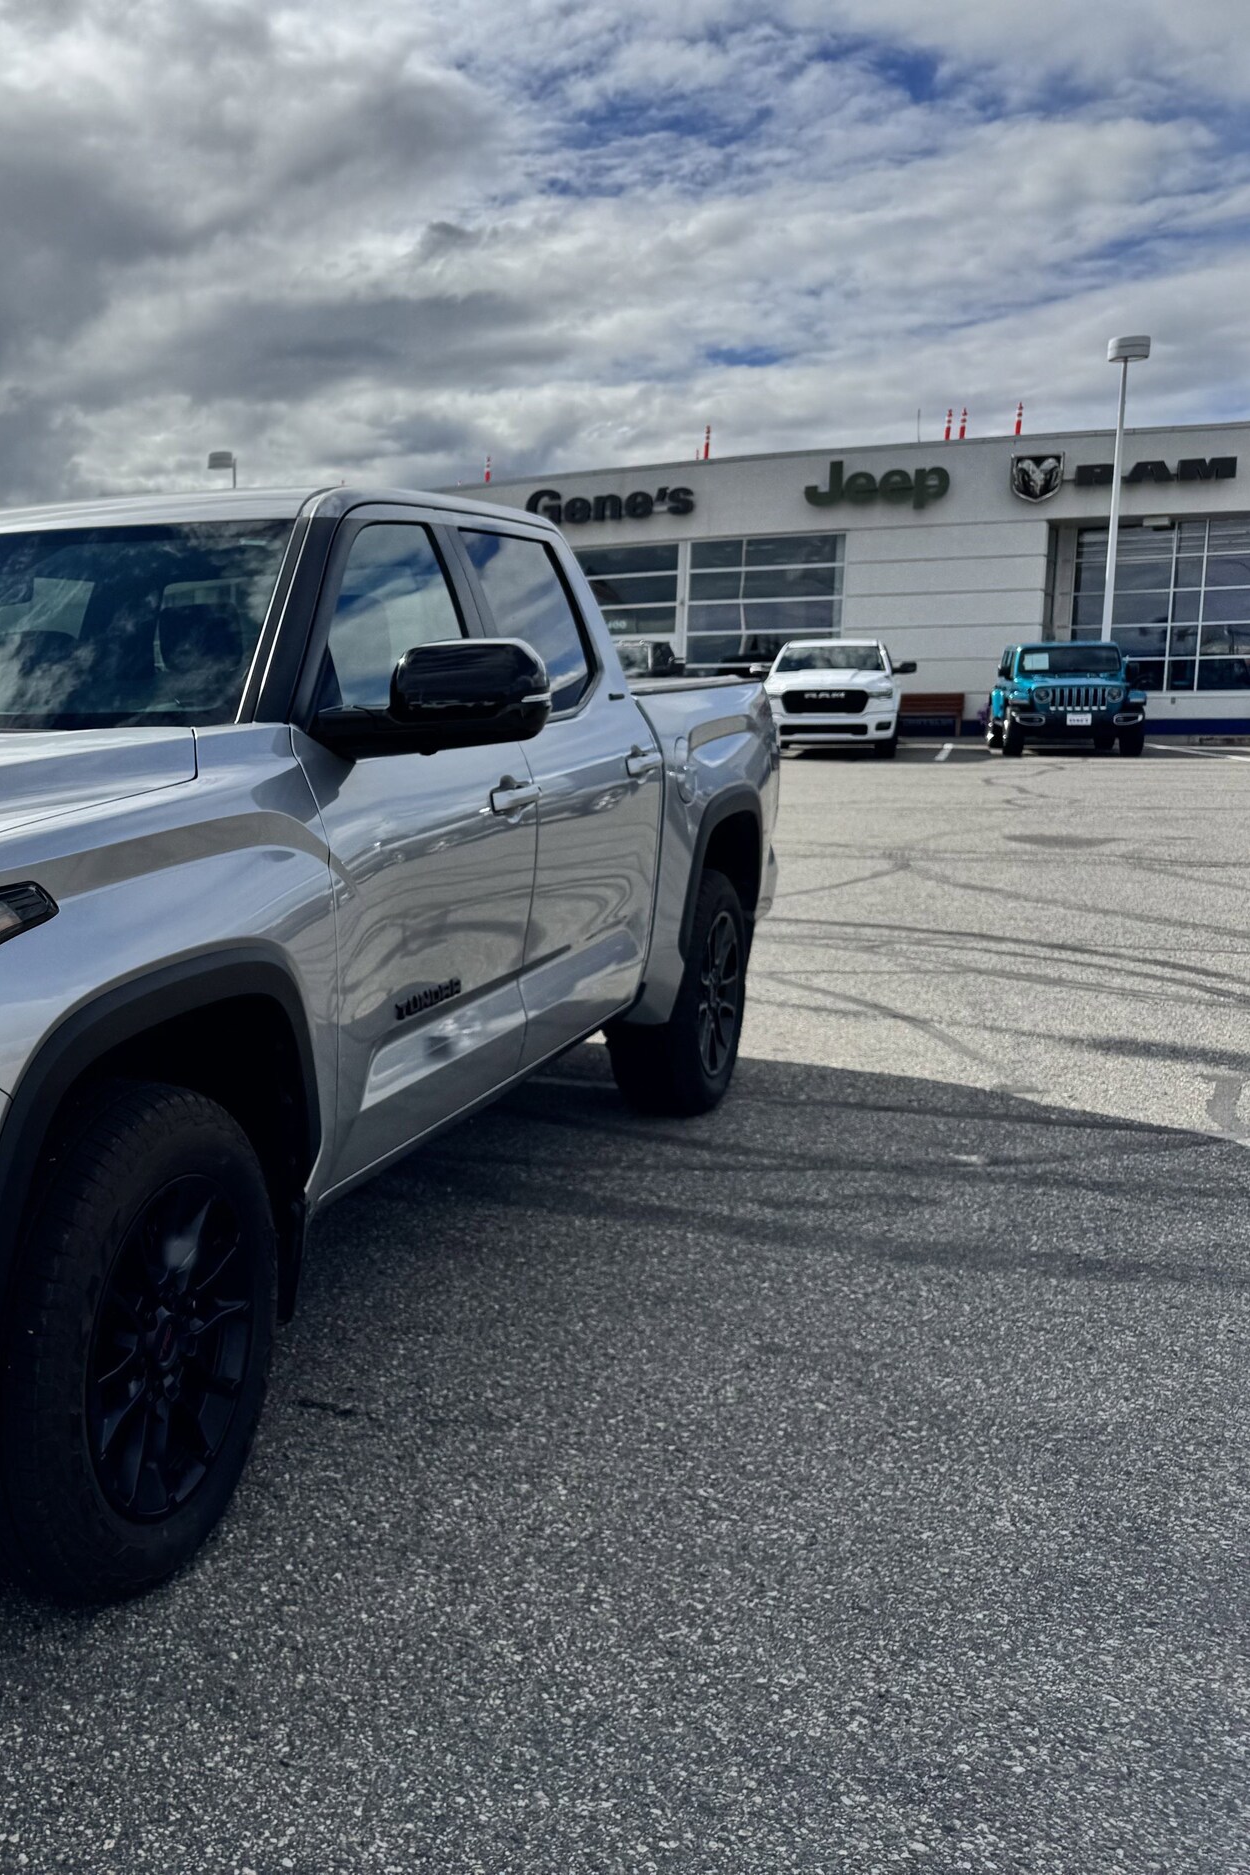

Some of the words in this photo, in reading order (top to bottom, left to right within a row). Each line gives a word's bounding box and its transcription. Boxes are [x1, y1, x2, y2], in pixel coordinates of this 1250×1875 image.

[804, 460, 950, 510] Jeep
[1075, 456, 1238, 486] RAM
[526, 486, 695, 525] Gene's
[394, 977, 462, 1021] TUNDRA
